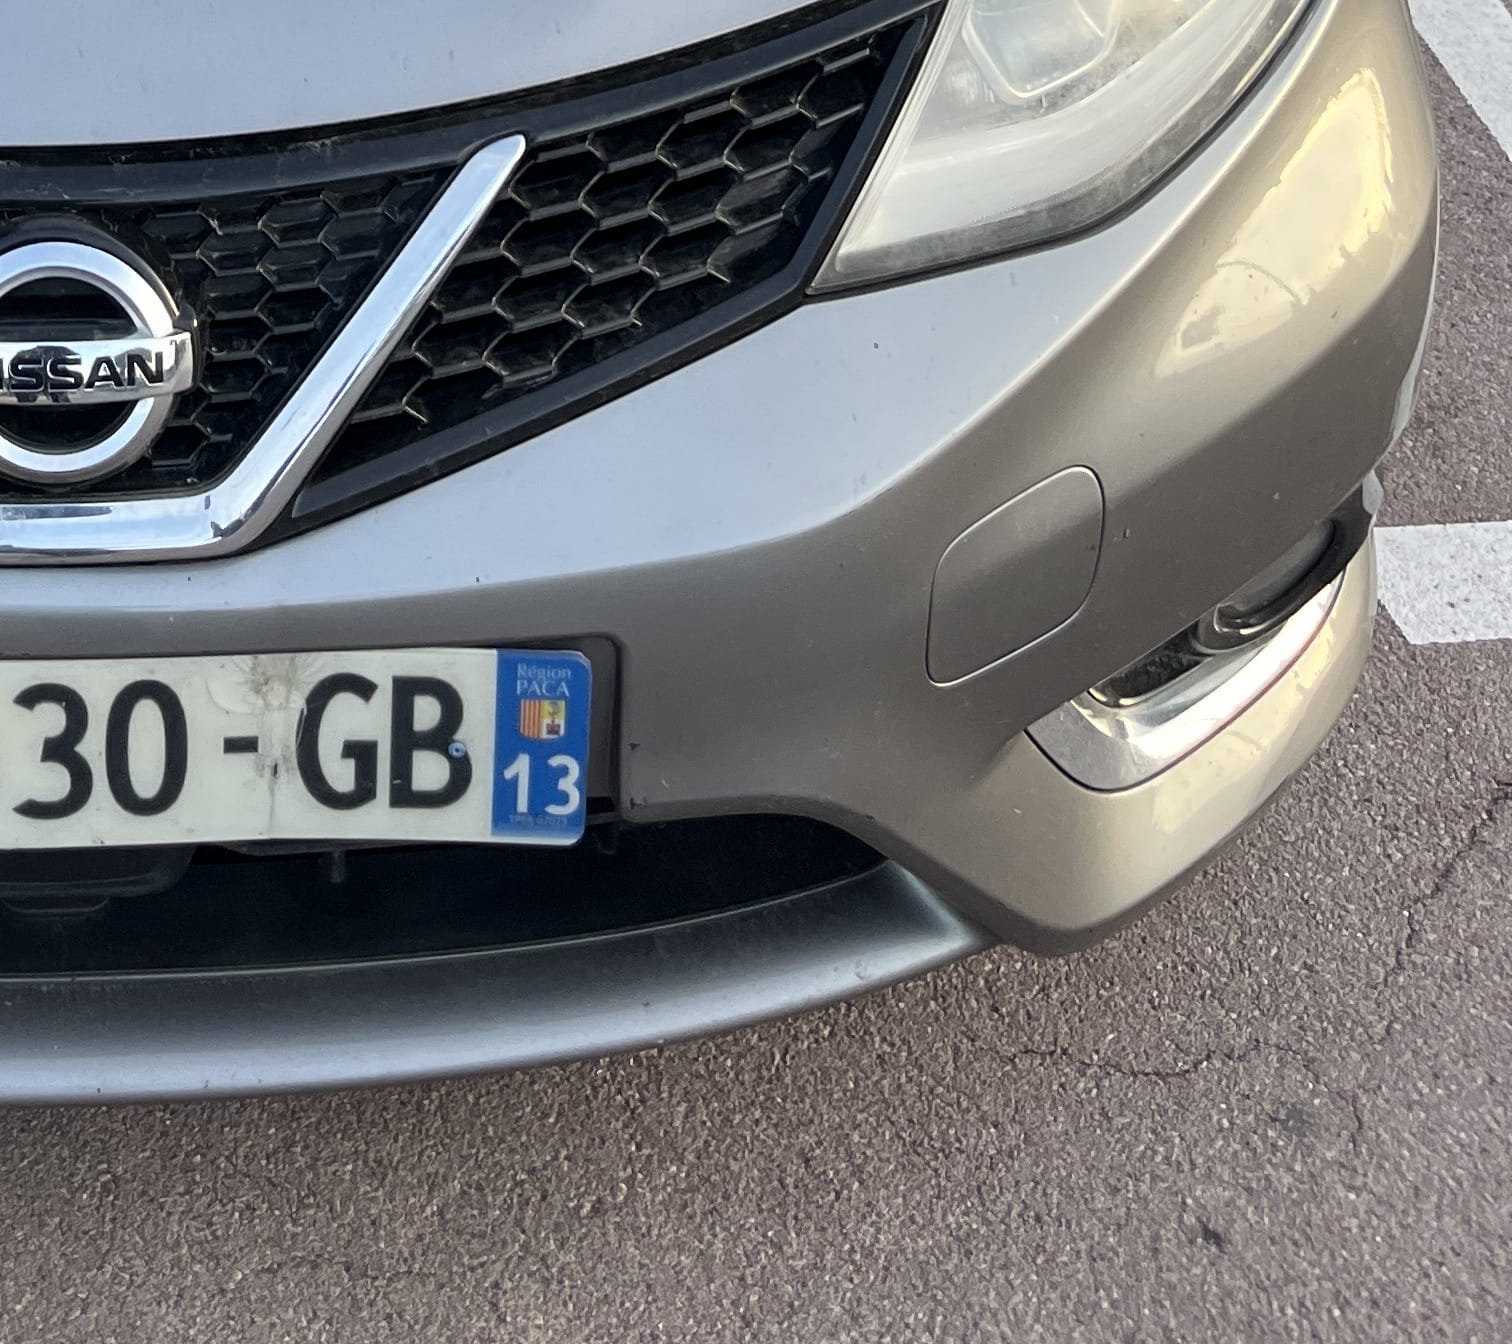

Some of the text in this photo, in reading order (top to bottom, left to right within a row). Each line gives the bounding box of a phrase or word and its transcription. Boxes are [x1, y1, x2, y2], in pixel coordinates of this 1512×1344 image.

[516, 663, 572, 681] Région
[516, 680, 570, 698] PACA
[503, 753, 580, 816] 13
